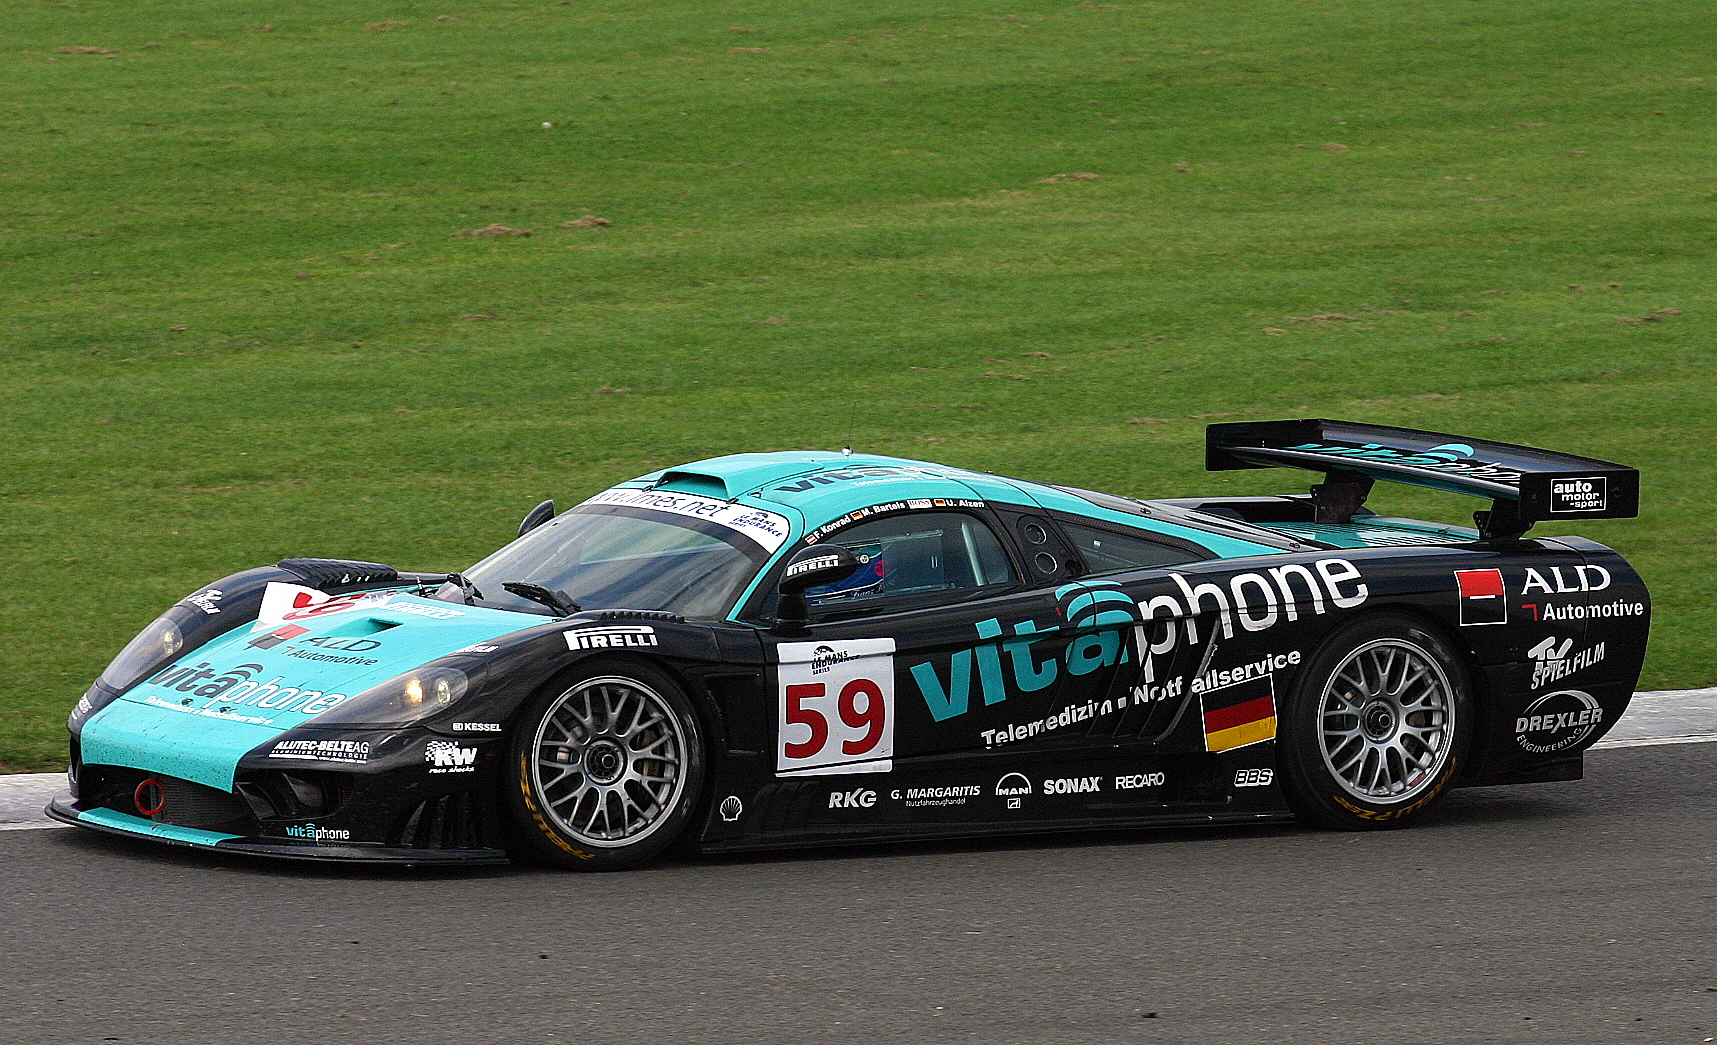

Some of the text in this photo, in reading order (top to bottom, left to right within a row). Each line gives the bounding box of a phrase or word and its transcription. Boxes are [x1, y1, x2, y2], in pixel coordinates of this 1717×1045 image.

[1553, 480, 1593, 494] auto
[1561, 491, 1600, 502] motor
[732, 518, 784, 538] ENDURANCE
[813, 529, 824, 540] F.
[821, 515, 852, 534] Konrad
[860, 507, 874, 517] M.
[873, 501, 906, 514] Bartels
[959, 500, 985, 508] Alzen
[786, 554, 839, 577] PIRELLI
[1520, 564, 1612, 596] ALD
[1542, 599, 1644, 621] Automotive
[300, 636, 382, 652] ALD
[562, 625, 659, 651] PIRELLI
[909, 558, 1369, 724] vitaphone
[289, 649, 379, 667] Automotive
[824, 650, 849, 661] MANS
[1527, 636, 1574, 676] TV
[1531, 641, 1605, 690] SPIELFILM
[148, 662, 347, 715] vitaphone
[464, 722, 502, 732] KESSEL
[784, 678, 886, 759] 59
[981, 698, 1113, 749] Telemedizin
[1515, 707, 1604, 734] DREXLER
[1516, 727, 1583, 754] ENGINEERING
[433, 747, 478, 766] KW
[1043, 776, 1101, 795] SONAX
[1115, 772, 1165, 790] RECARO
[1234, 768, 1273, 788] BBS
[828, 787, 877, 808] RKG
[890, 785, 981, 800] G. MARGARITIS
[998, 787, 1030, 795] MAN
[285, 822, 350, 841] vitaphone
